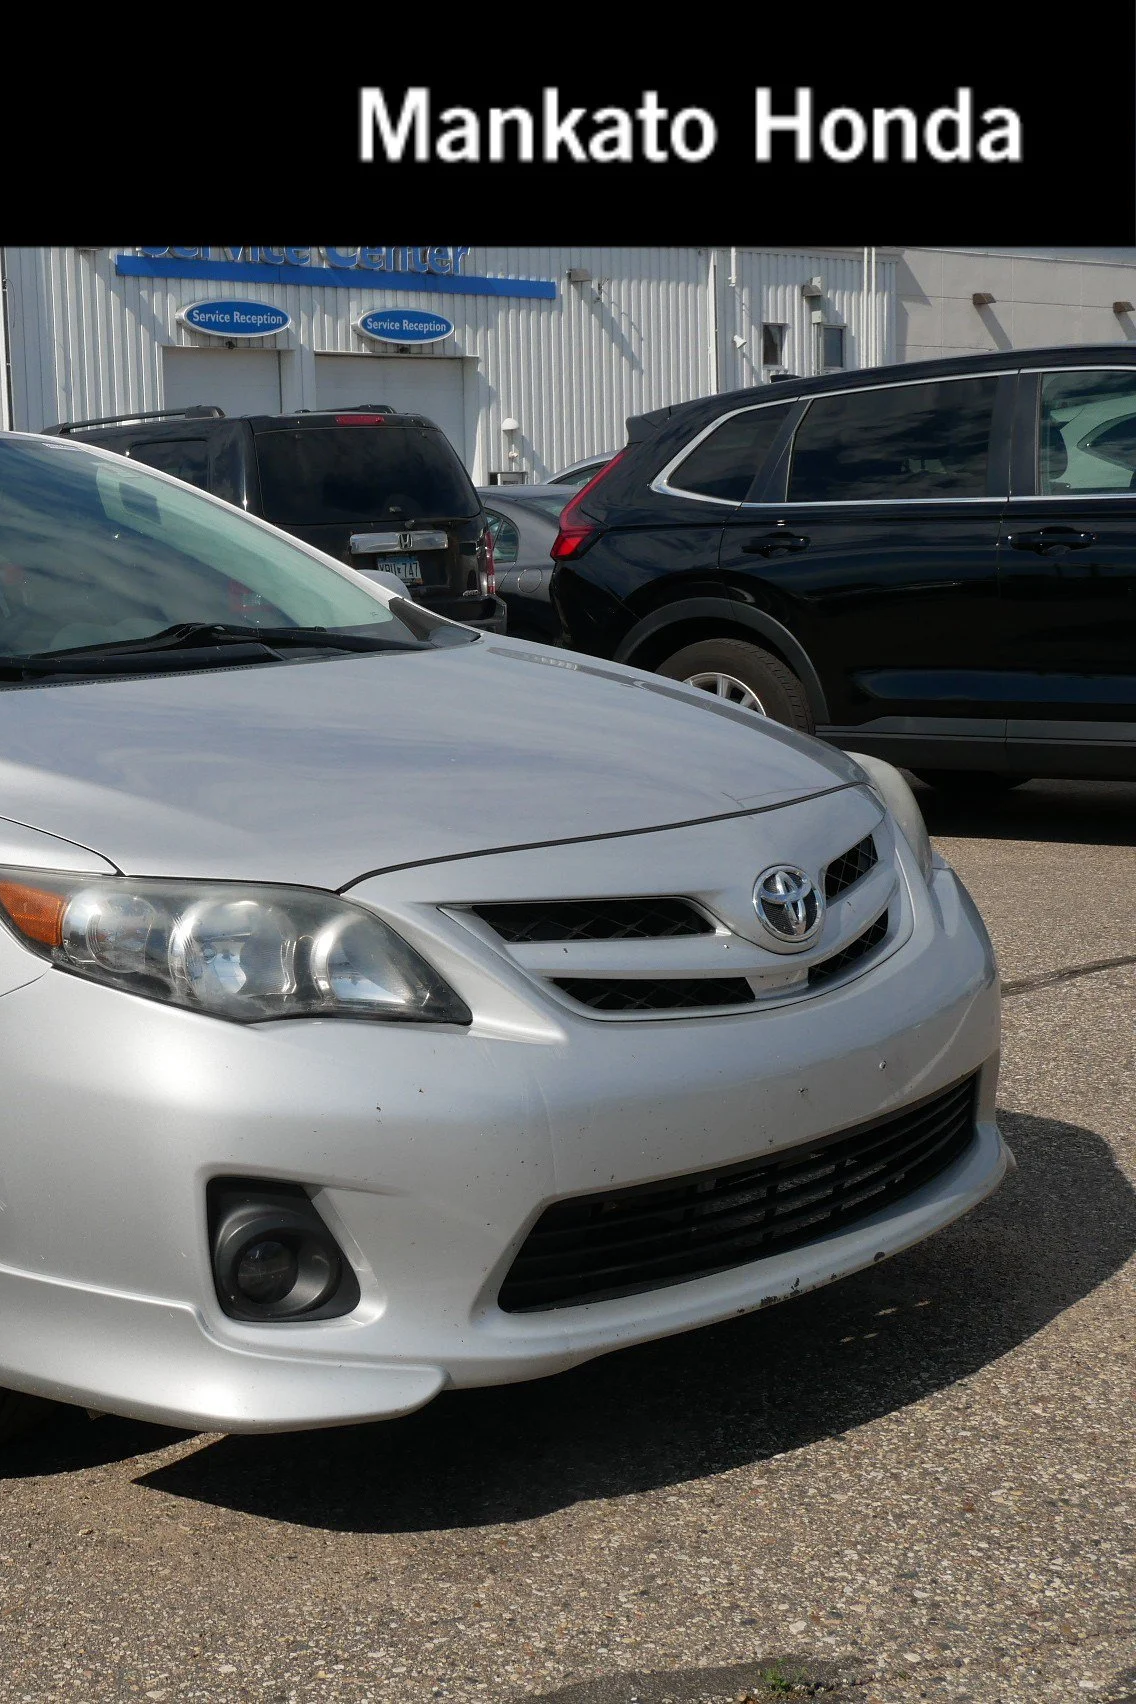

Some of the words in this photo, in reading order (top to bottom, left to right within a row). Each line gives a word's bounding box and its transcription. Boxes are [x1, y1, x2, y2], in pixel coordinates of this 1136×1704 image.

[139, 246, 311, 266] rvce
[192, 310, 231, 323] Service
[233, 311, 283, 327] Reception
[366, 318, 400, 330] Service
[402, 319, 447, 334] Reception
